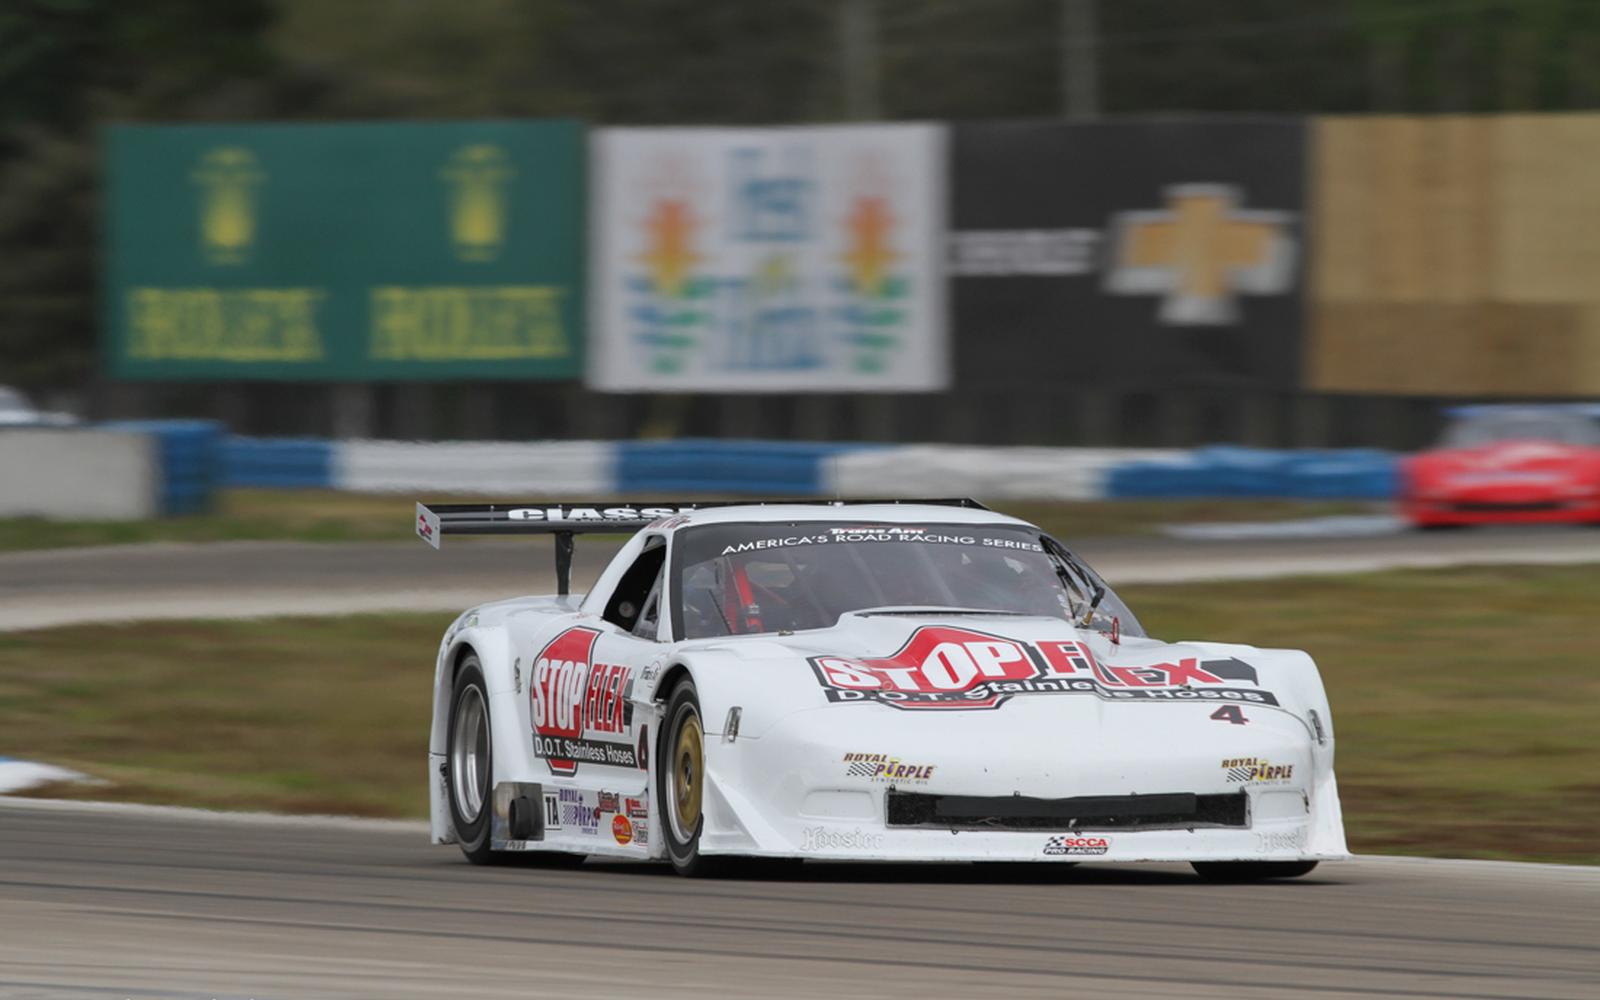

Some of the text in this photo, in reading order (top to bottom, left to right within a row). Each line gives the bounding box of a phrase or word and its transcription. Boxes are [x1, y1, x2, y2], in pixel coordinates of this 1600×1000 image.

[721, 534, 1044, 555] AMERICA'S ROAD RACING SERIES
[822, 641, 1224, 690] STOP FLEX
[532, 657, 587, 731] STOP
[584, 663, 632, 734] FLEX
[1146, 690, 1266, 703] Hoses
[1210, 705, 1249, 725] 4
[535, 737, 635, 765] D.O.T. Stainless Hoses
[638, 723, 649, 772] 4
[843, 753, 888, 762] ROYAL
[874, 762, 934, 779] PURPLE
[1222, 758, 1257, 768] ROYAL
[1249, 764, 1294, 781] PURPLE
[545, 796, 560, 825] TA
[800, 825, 885, 851] Hoosier
[1064, 838, 1108, 847] SCCA
